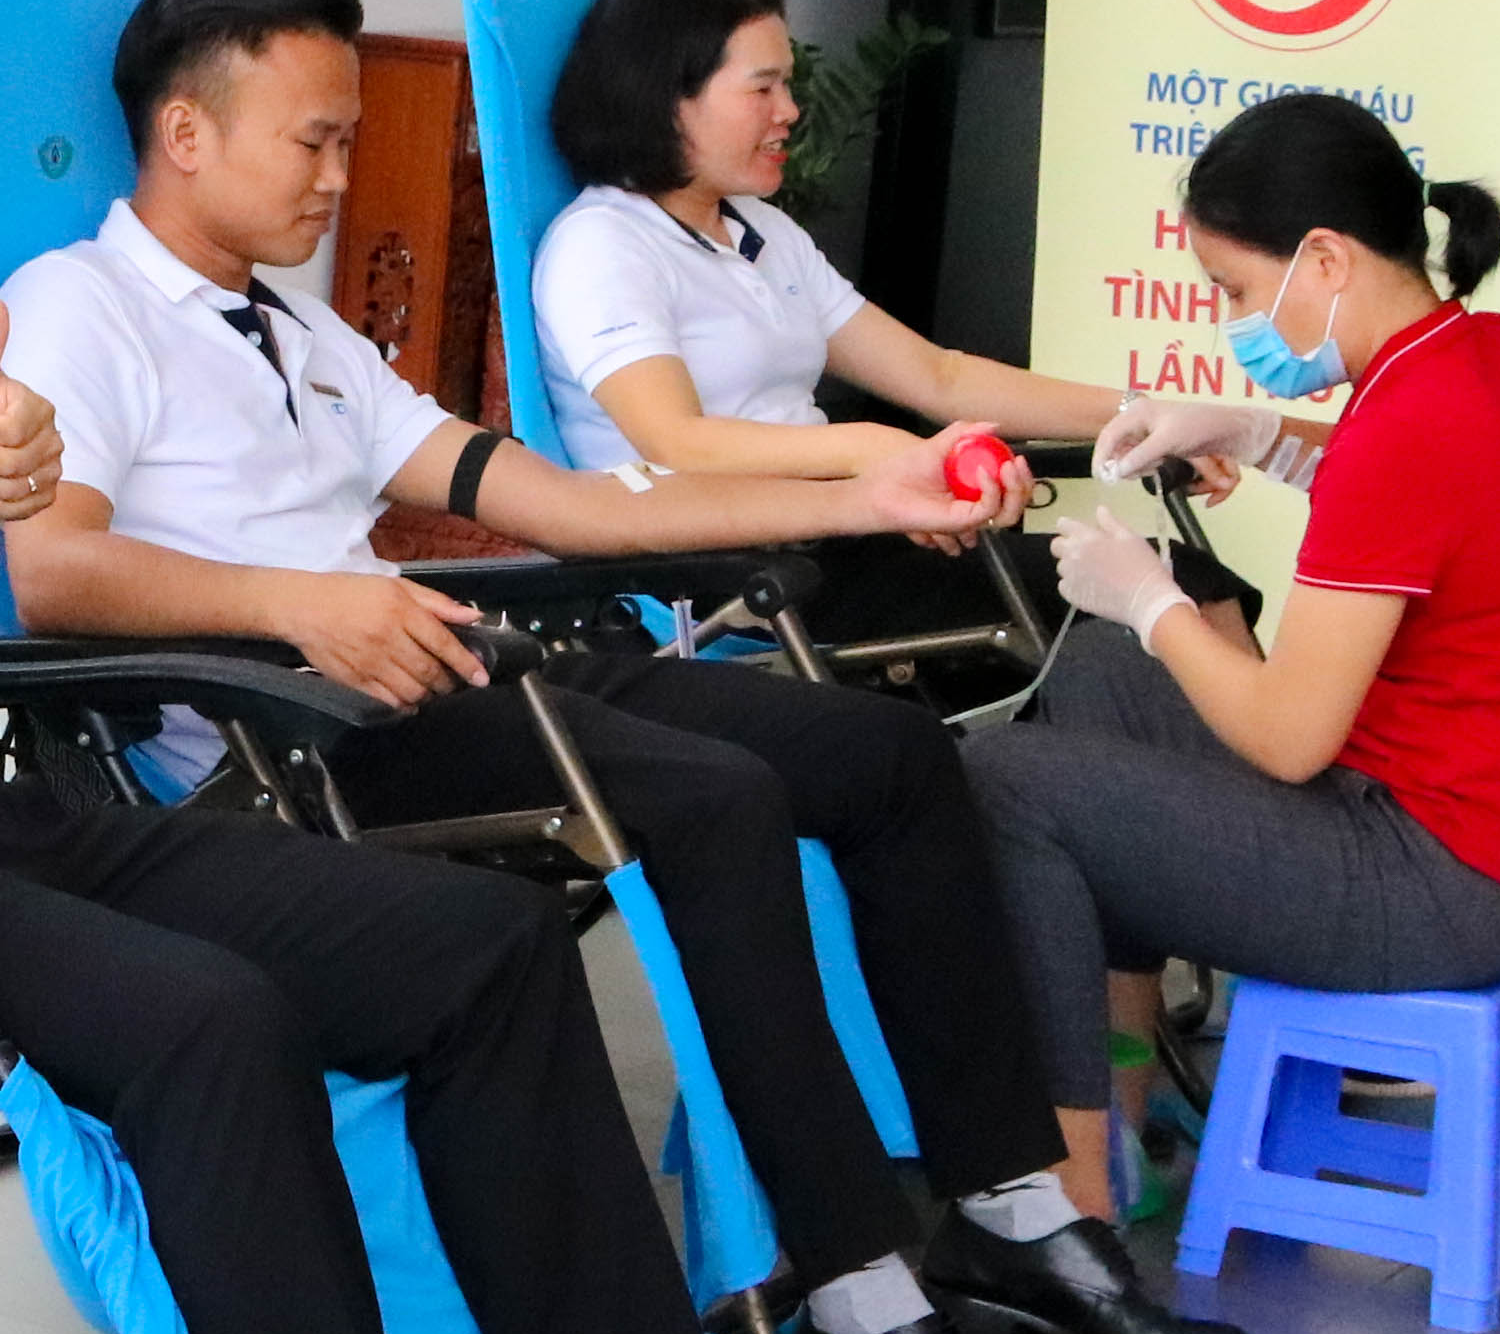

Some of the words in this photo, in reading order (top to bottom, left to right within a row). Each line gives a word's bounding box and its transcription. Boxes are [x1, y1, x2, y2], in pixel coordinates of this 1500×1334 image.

[1146, 69, 1229, 115] MỘT
[1104, 269, 1221, 325] TÌNH
[1128, 340, 1225, 397] LẦN
